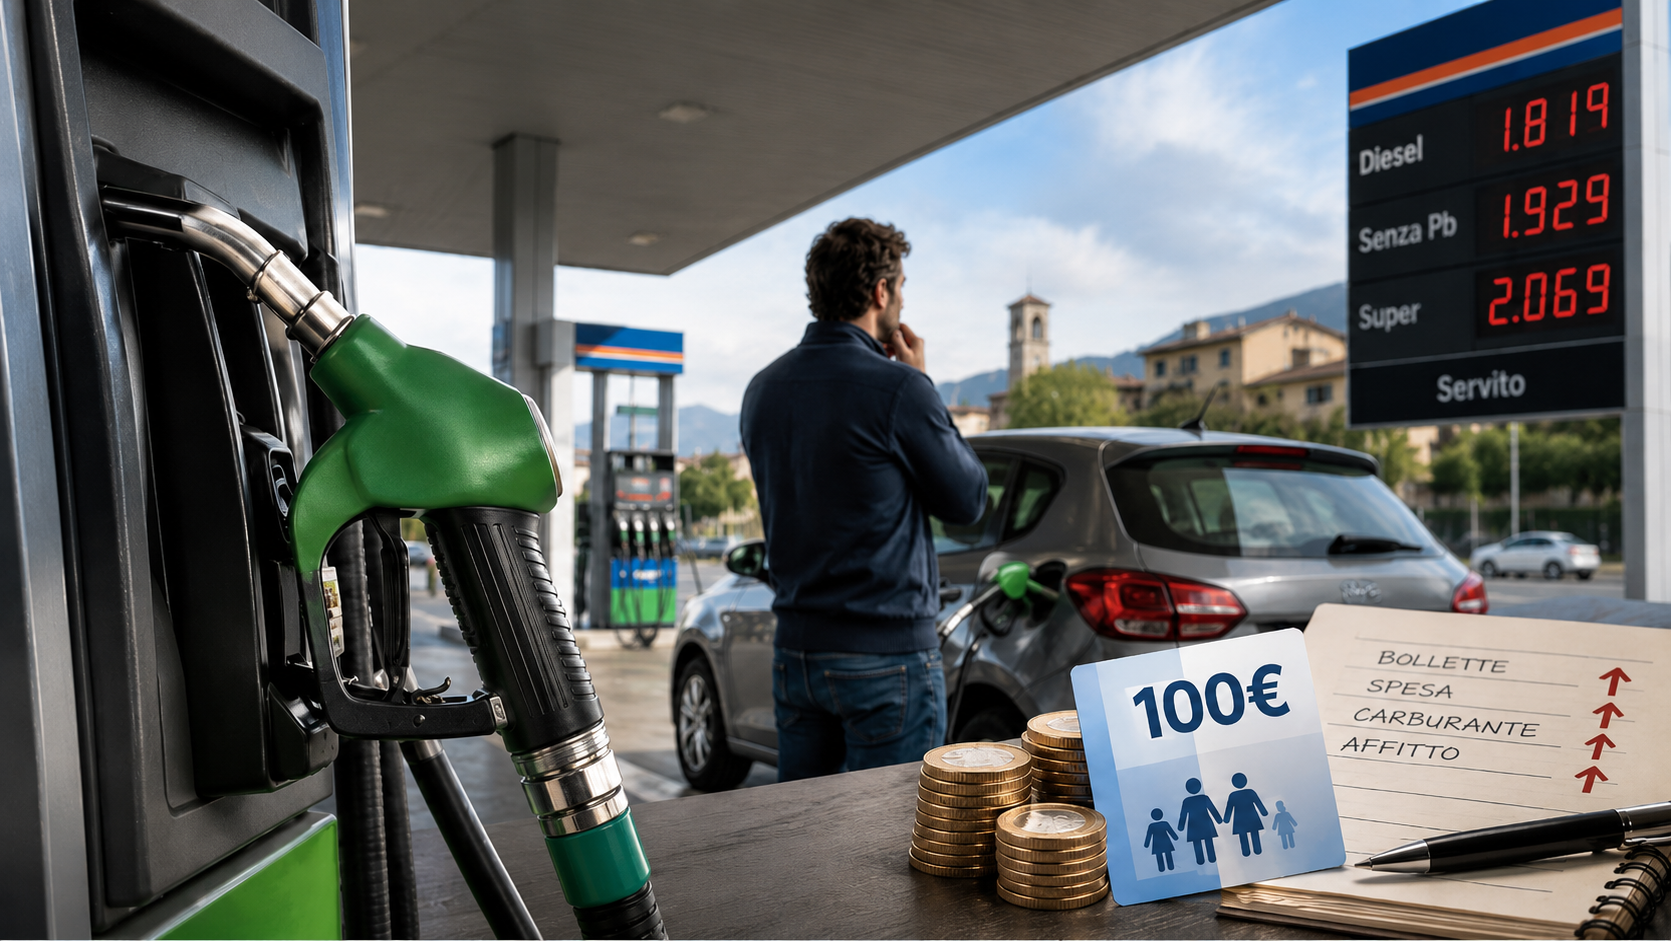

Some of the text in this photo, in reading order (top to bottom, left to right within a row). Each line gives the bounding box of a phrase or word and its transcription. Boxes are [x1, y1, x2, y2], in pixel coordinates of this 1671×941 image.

[1503, 82, 1609, 152] 1.819
[1359, 134, 1423, 176] Diesel
[1503, 173, 1610, 239] 1.929
[1359, 210, 1457, 253] Senza Pb
[1488, 263, 1610, 326] 2.069
[1358, 301, 1421, 332] Super
[1436, 370, 1526, 402] Servito
[1377, 650, 1509, 673] BOLLETTE
[1132, 663, 1290, 739] 100€
[1366, 679, 1453, 699] SPESA
[1353, 707, 1540, 737] CARBURANTE
[1340, 737, 1460, 761] AFFITTO
